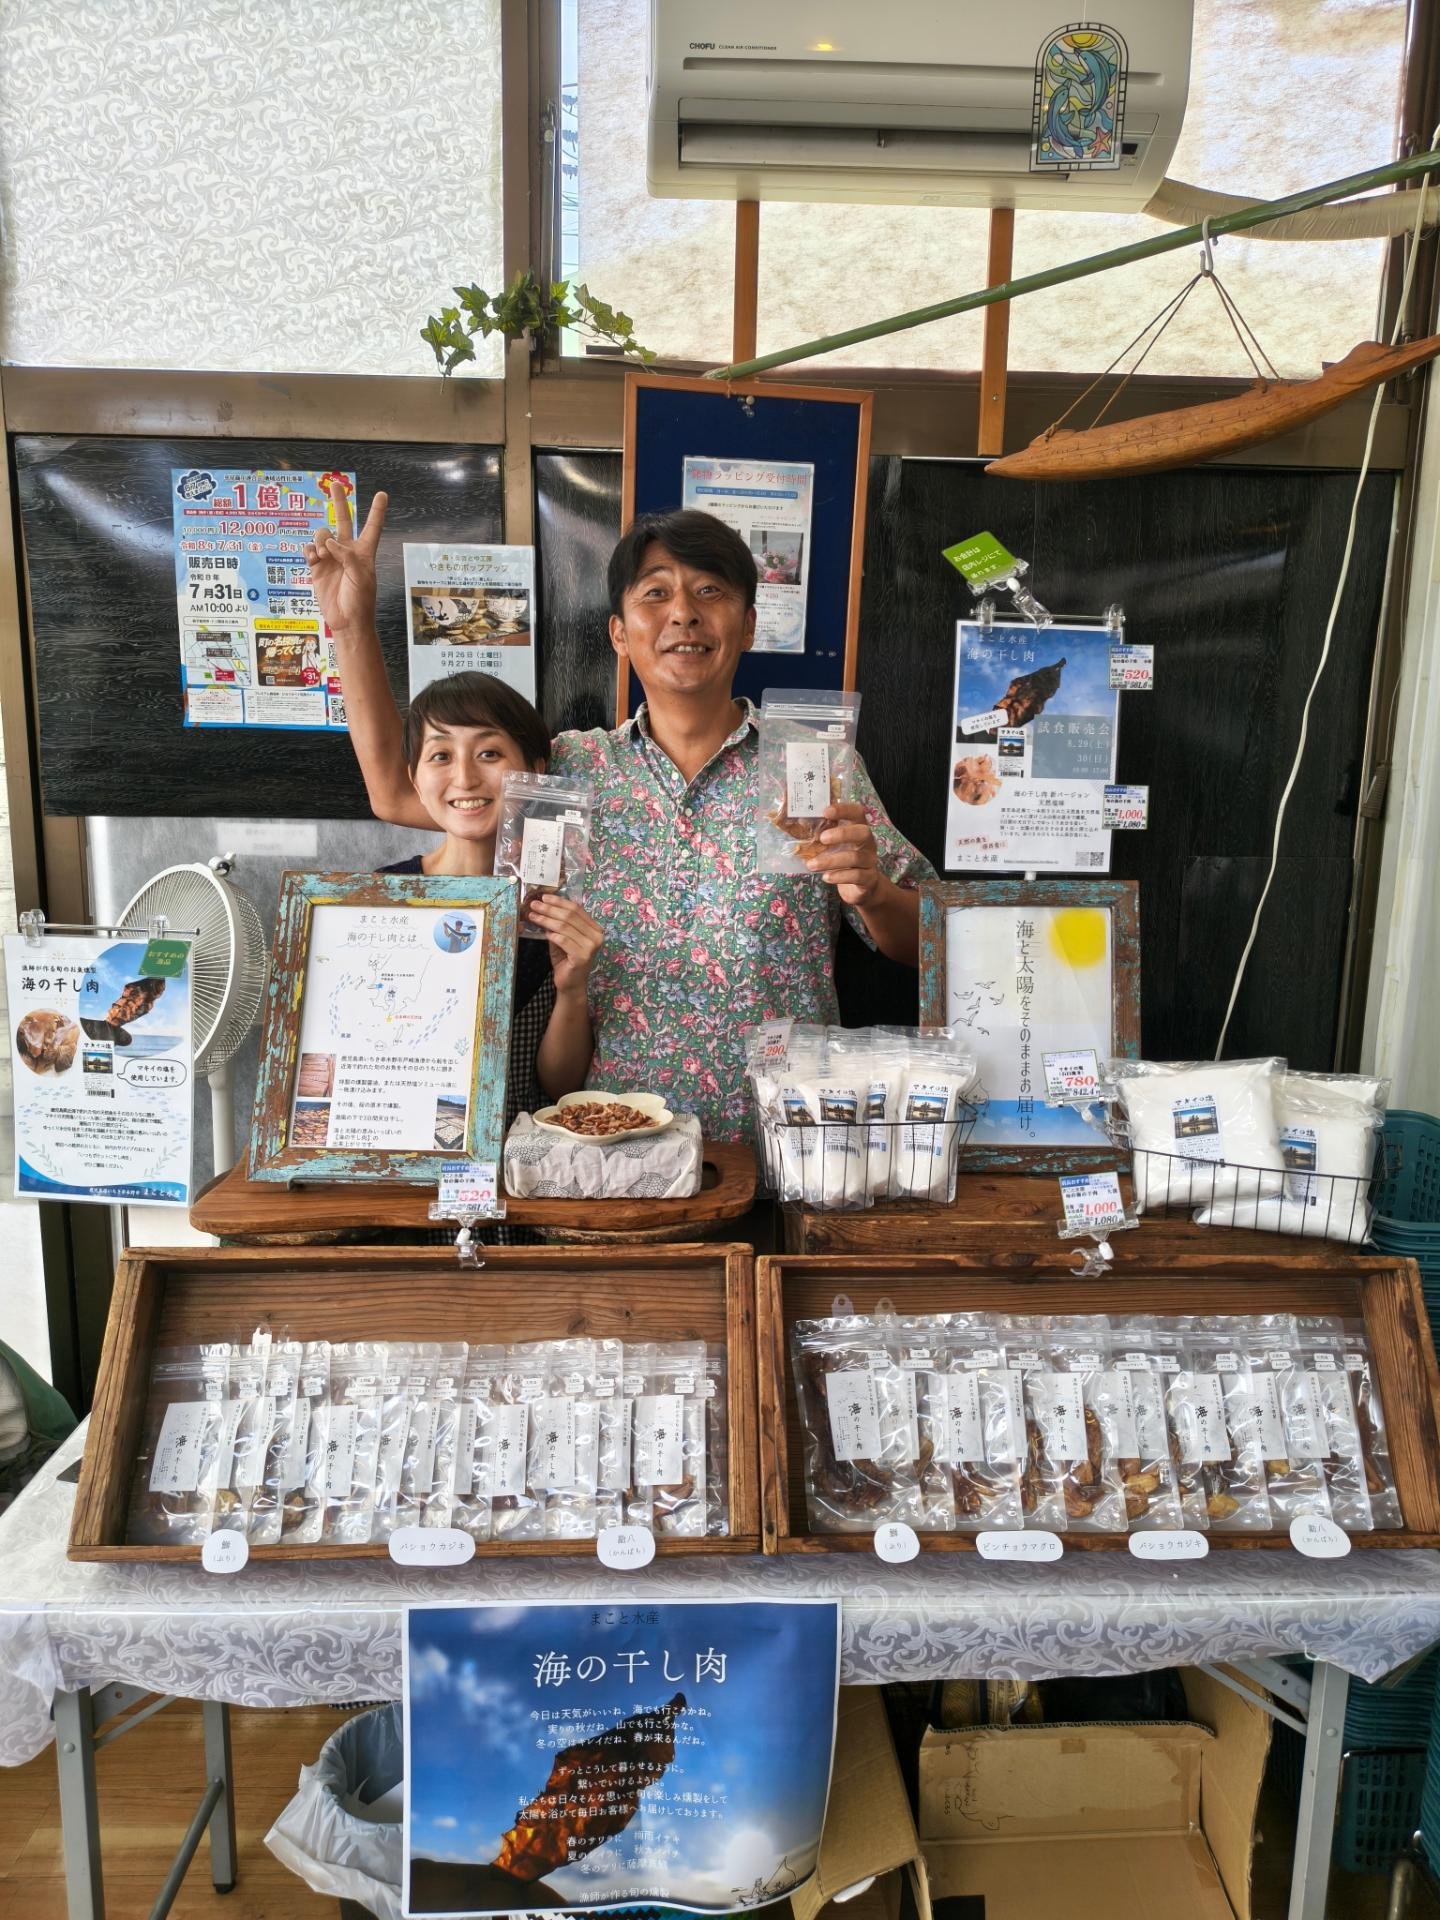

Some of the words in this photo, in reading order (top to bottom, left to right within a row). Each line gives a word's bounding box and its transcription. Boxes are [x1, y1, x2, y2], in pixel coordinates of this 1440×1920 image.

[220, 521, 276, 535] 12,000
[189, 557, 239, 569] 販売日時
[430, 562, 508, 573] やきものポップアップ
[268, 566, 286, 576] 販売
[268, 576, 286, 584] 場所
[189, 584, 242, 600] 7月31日
[967, 647, 1035, 662] 海の干し肉
[1125, 669, 1148, 680] 520
[1038, 722, 1110, 735] 試食販売会
[1119, 810, 1142, 819] 1,000
[360, 914, 409, 924] まこと水産
[347, 932, 417, 943] 海の干し肉とは
[22, 976, 99, 994] 海の干し肉
[1016, 919, 1036, 1139] 海と太陽をそのままお届け。
[913, 1083, 948, 1093] マキイの塩
[1066, 1076, 1094, 1087] 780
[820, 1088, 856, 1096] マキイの塩
[1174, 1096, 1215, 1106] マキイの塩
[143, 1188, 181, 1198] まこと水産
[460, 1190, 491, 1202] 520
[1086, 1202, 1117, 1216] 1,000
[1094, 1215, 1118, 1226] 1,080
[848, 1402, 862, 1450] 海の干し肉
[950, 1406, 964, 1454] 海の干し肉
[1054, 1405, 1067, 1452] 海の干し肉
[1195, 1406, 1211, 1452] 海の干し肉
[1249, 1406, 1267, 1452] 海の干し肉
[171, 1434, 188, 1482] 海の干し肉
[546, 1431, 559, 1480] 海の干し肉
[654, 1428, 666, 1477] 海の干し肉
[325, 1440, 338, 1489] 海の干し肉
[499, 1438, 510, 1488] 海の干し肉
[400, 1541, 466, 1552] バショウカジキ
[982, 1542, 1056, 1551] ビンチョウマグロ
[1138, 1539, 1202, 1550] バショウカジキ
[590, 1610, 660, 1626] まこと水産
[532, 1646, 729, 1688] 海の干し肉
[558, 1762, 686, 1776] ずっとこうして暮らせるように。
